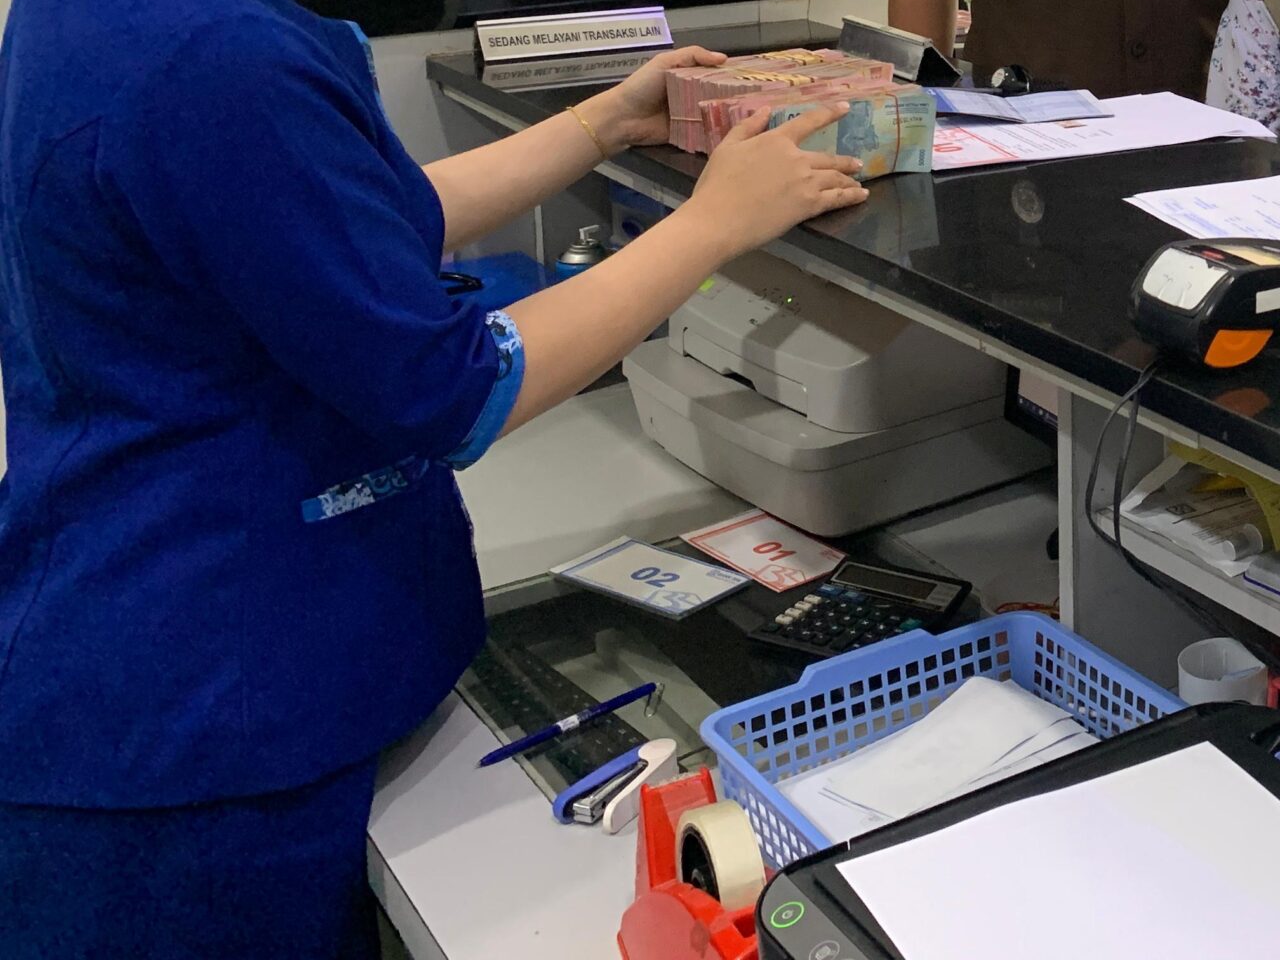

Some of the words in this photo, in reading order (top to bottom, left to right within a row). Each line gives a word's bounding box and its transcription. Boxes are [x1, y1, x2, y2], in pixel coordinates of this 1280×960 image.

[488, 35, 531, 48] SEDANG
[532, 31, 581, 45] MELAYANI
[582, 27, 638, 41] TRANSAKSI
[640, 26, 661, 37] LAIN
[752, 541, 797, 562] 01
[630, 566, 680, 588] 02
